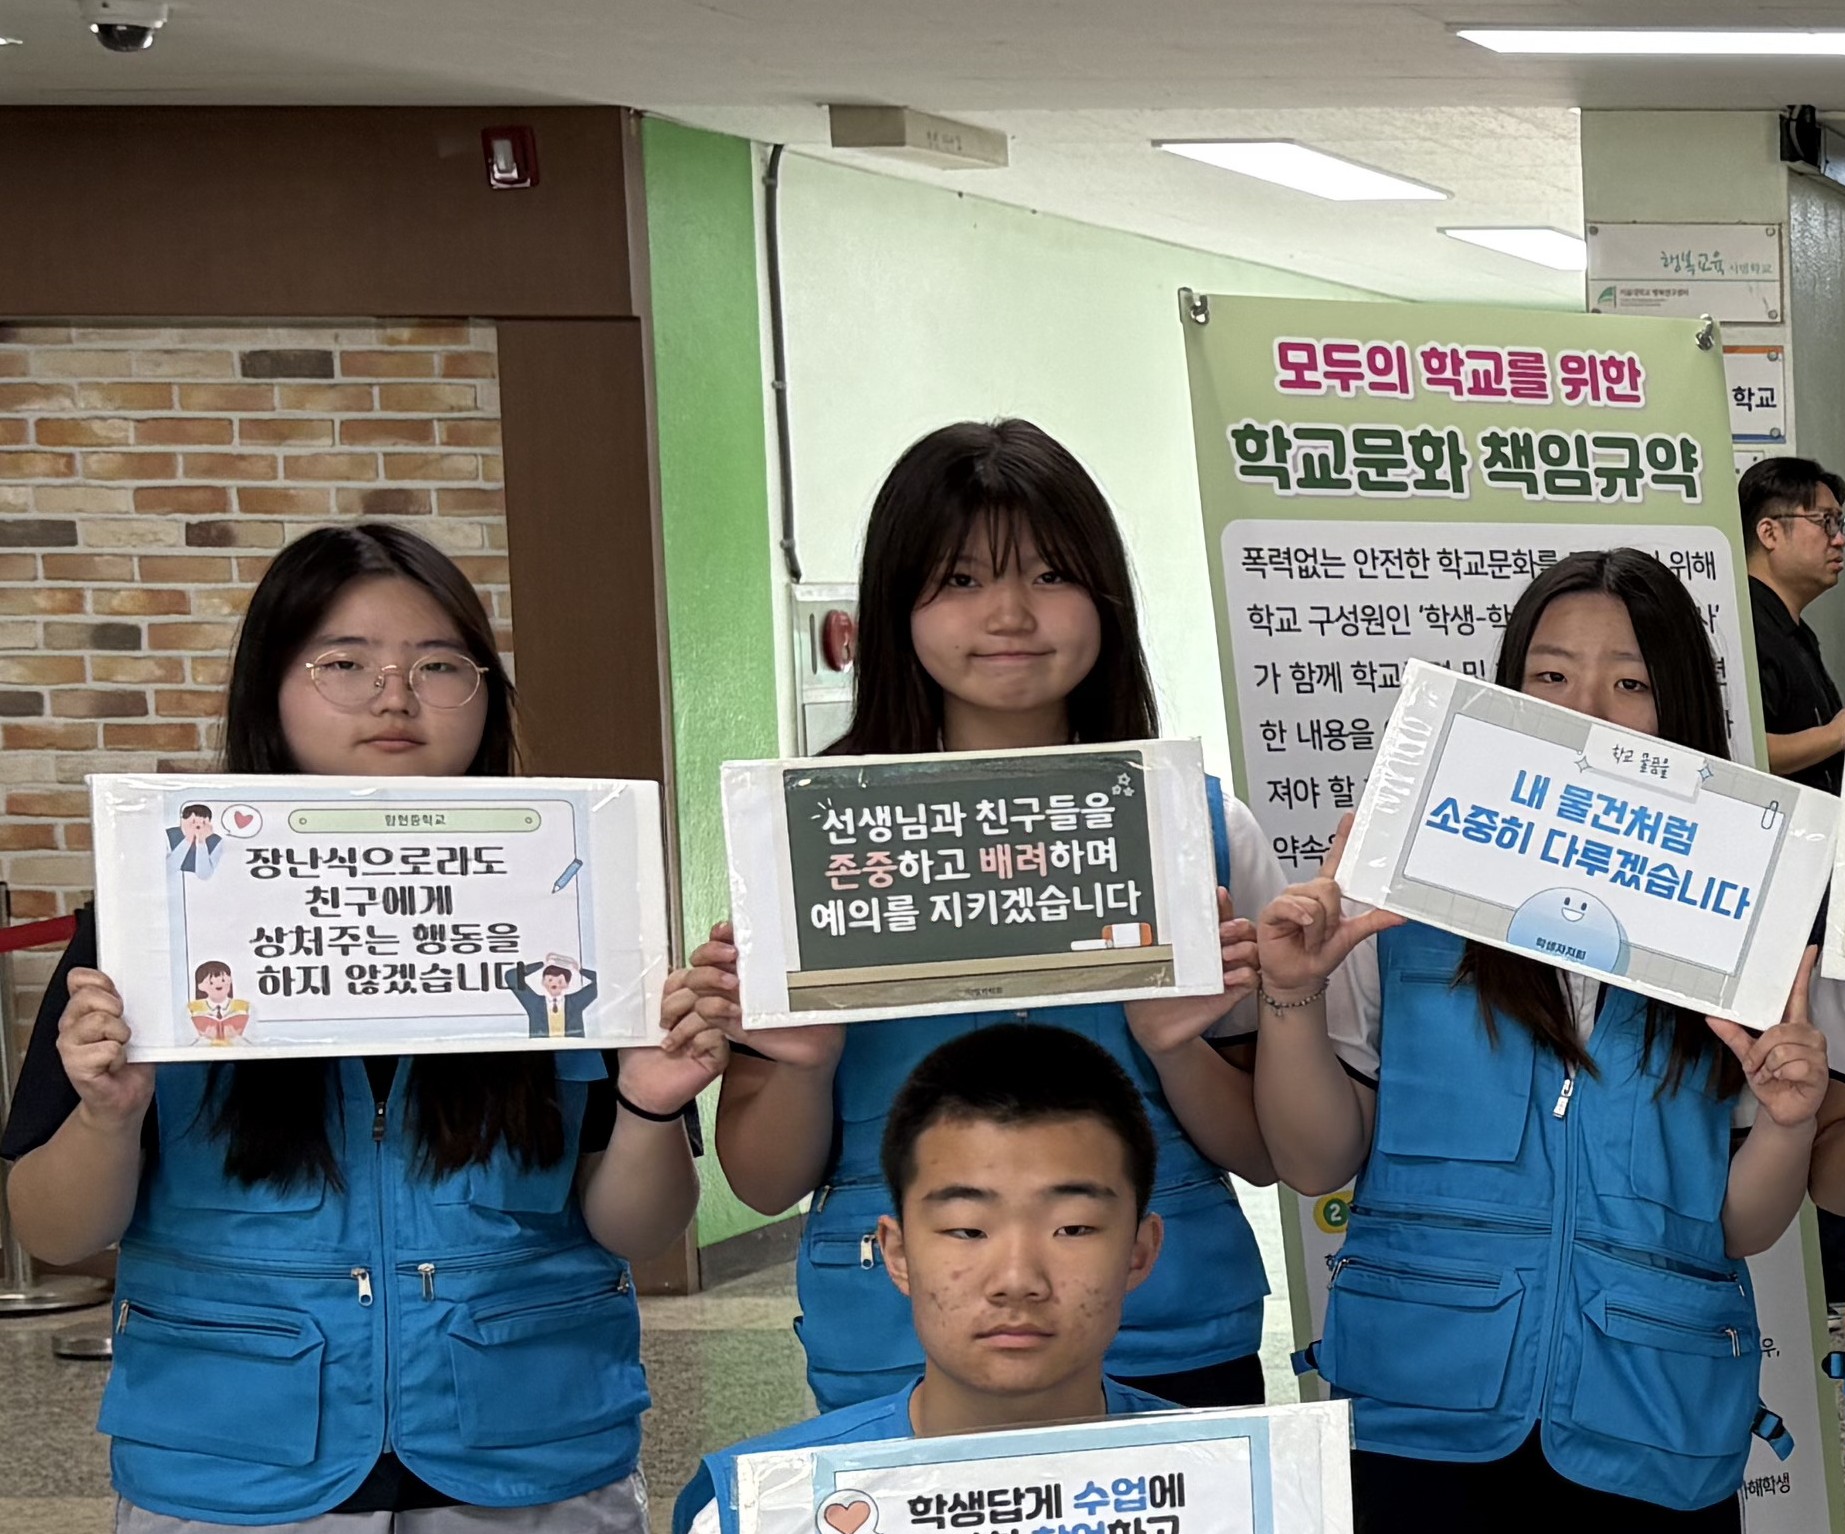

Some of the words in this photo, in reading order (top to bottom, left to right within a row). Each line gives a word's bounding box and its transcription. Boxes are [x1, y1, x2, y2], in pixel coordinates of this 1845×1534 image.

[1277, 341, 1409, 393] 모두의
[1421, 347, 1549, 399] 학교를
[1560, 354, 1642, 404] 위한
[1732, 386, 1777, 411] 학교
[1230, 423, 1468, 495] 학교문화
[1480, 431, 1699, 498] 책임규약
[1241, 547, 1346, 581] 폭력없는
[1353, 549, 1429, 580] 안전한
[1669, 550, 1717, 581] 위해
[1308, 605, 1412, 636] 구성원인
[1289, 662, 1343, 694] 함께
[1296, 718, 1375, 751] 내용을
[822, 800, 967, 846] 선생님과
[975, 791, 1116, 836] 친구들을
[1510, 769, 1552, 811] 내
[1557, 783, 1699, 857] 물건처럼
[245, 846, 508, 879] 장난식으로라도
[825, 848, 971, 891] 존중하고
[979, 837, 1118, 880] 배려하며
[1425, 796, 1534, 855] 소중히
[1540, 832, 1751, 921] 다루겠습니다
[304, 885, 454, 917] 친구에게
[810, 894, 920, 937] 예의를
[930, 880, 1142, 928] 지키겠습니다
[249, 925, 400, 958] 상처주는
[412, 923, 520, 955] 행동을
[256, 965, 331, 997] 하지
[345, 961, 528, 995] 않겠습니다
[907, 1483, 1063, 1530] 학생답게
[1072, 1472, 1186, 1516] 수업에
